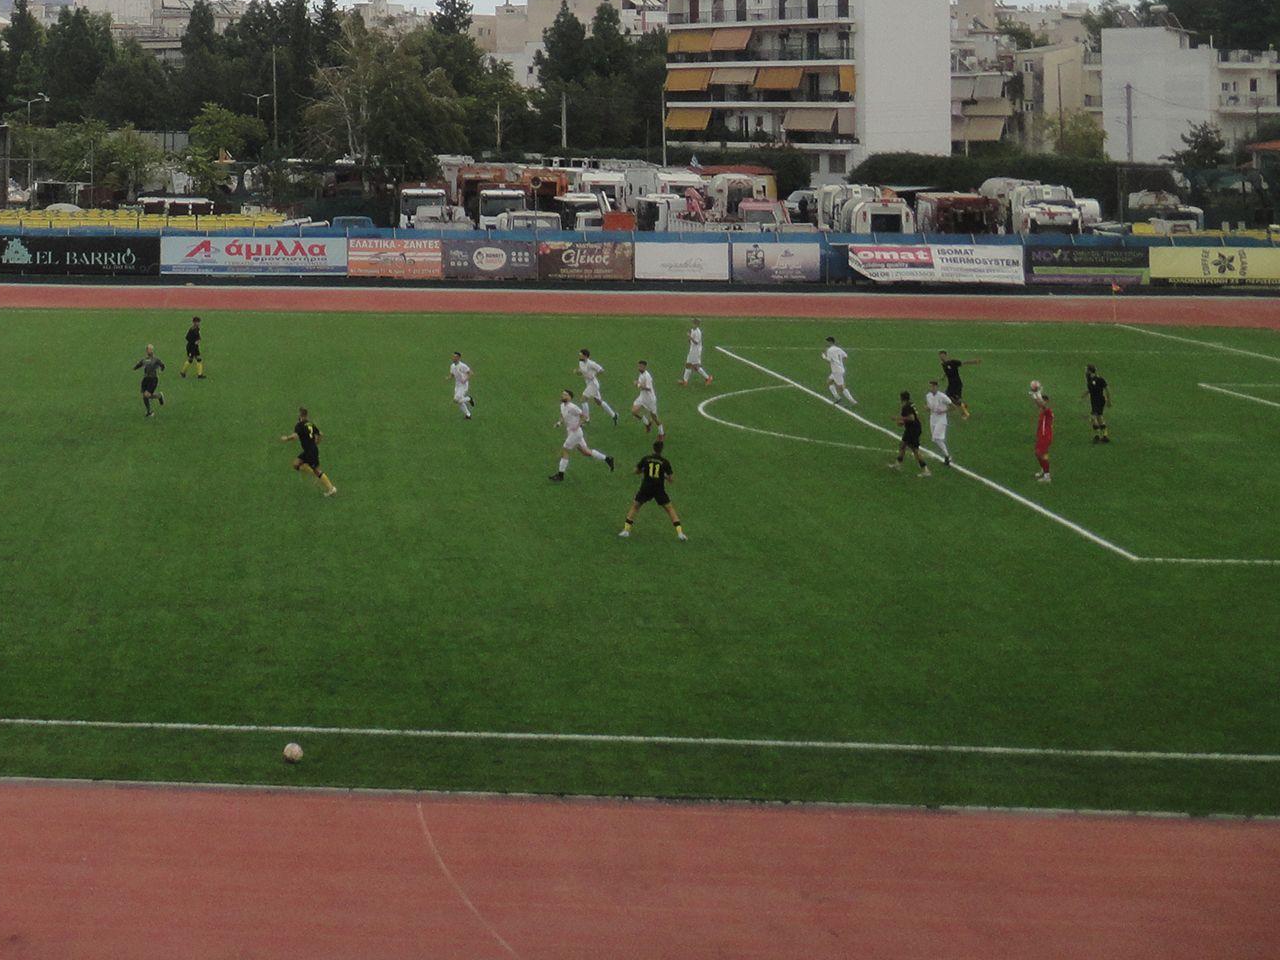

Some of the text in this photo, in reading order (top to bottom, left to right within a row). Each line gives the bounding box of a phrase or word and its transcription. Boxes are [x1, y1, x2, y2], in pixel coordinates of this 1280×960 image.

[349, 240, 396, 249] ΕΛΑΣΤΙΚΑ
[404, 240, 440, 249] ΖΑΝΤΕΣ
[225, 240, 327, 260] άμιλλα
[858, 249, 929, 260] omat
[937, 248, 974, 256] ISOMAT
[36, 248, 136, 265] EL BARRIO
[939, 257, 1020, 267] THERMOSYSTEM
